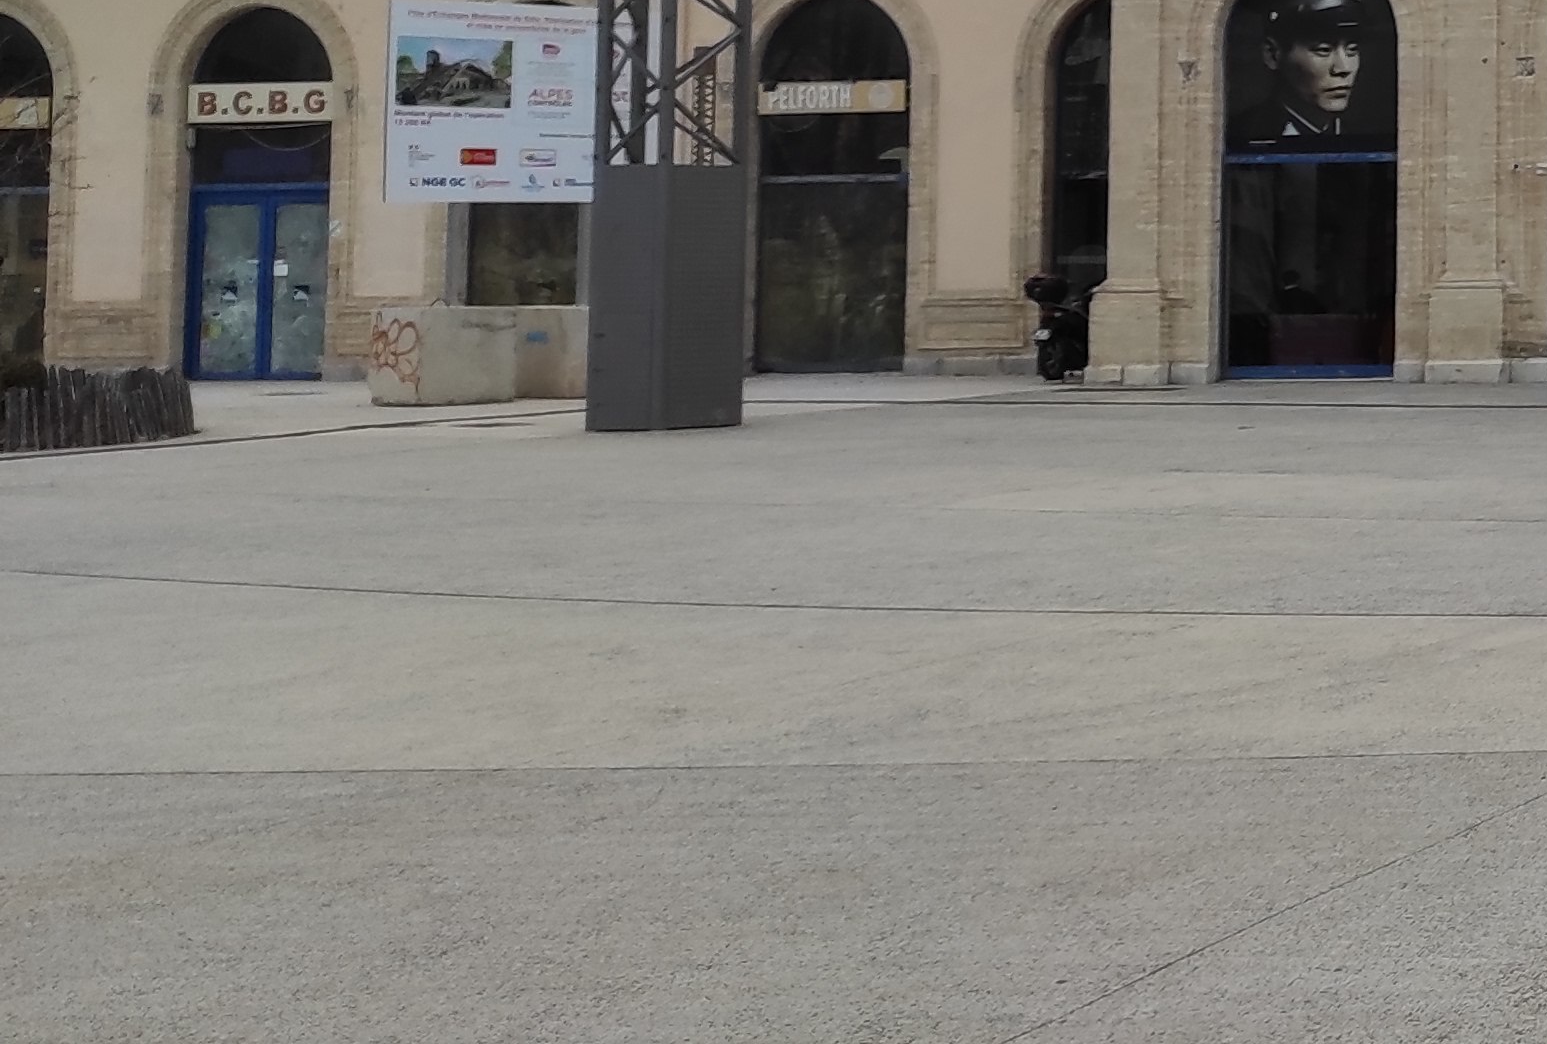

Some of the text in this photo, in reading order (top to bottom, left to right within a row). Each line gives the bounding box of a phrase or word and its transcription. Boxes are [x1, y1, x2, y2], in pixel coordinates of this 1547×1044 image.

[196, 89, 326, 117] B.C.B.G
[421, 177, 467, 188] NGE GC
